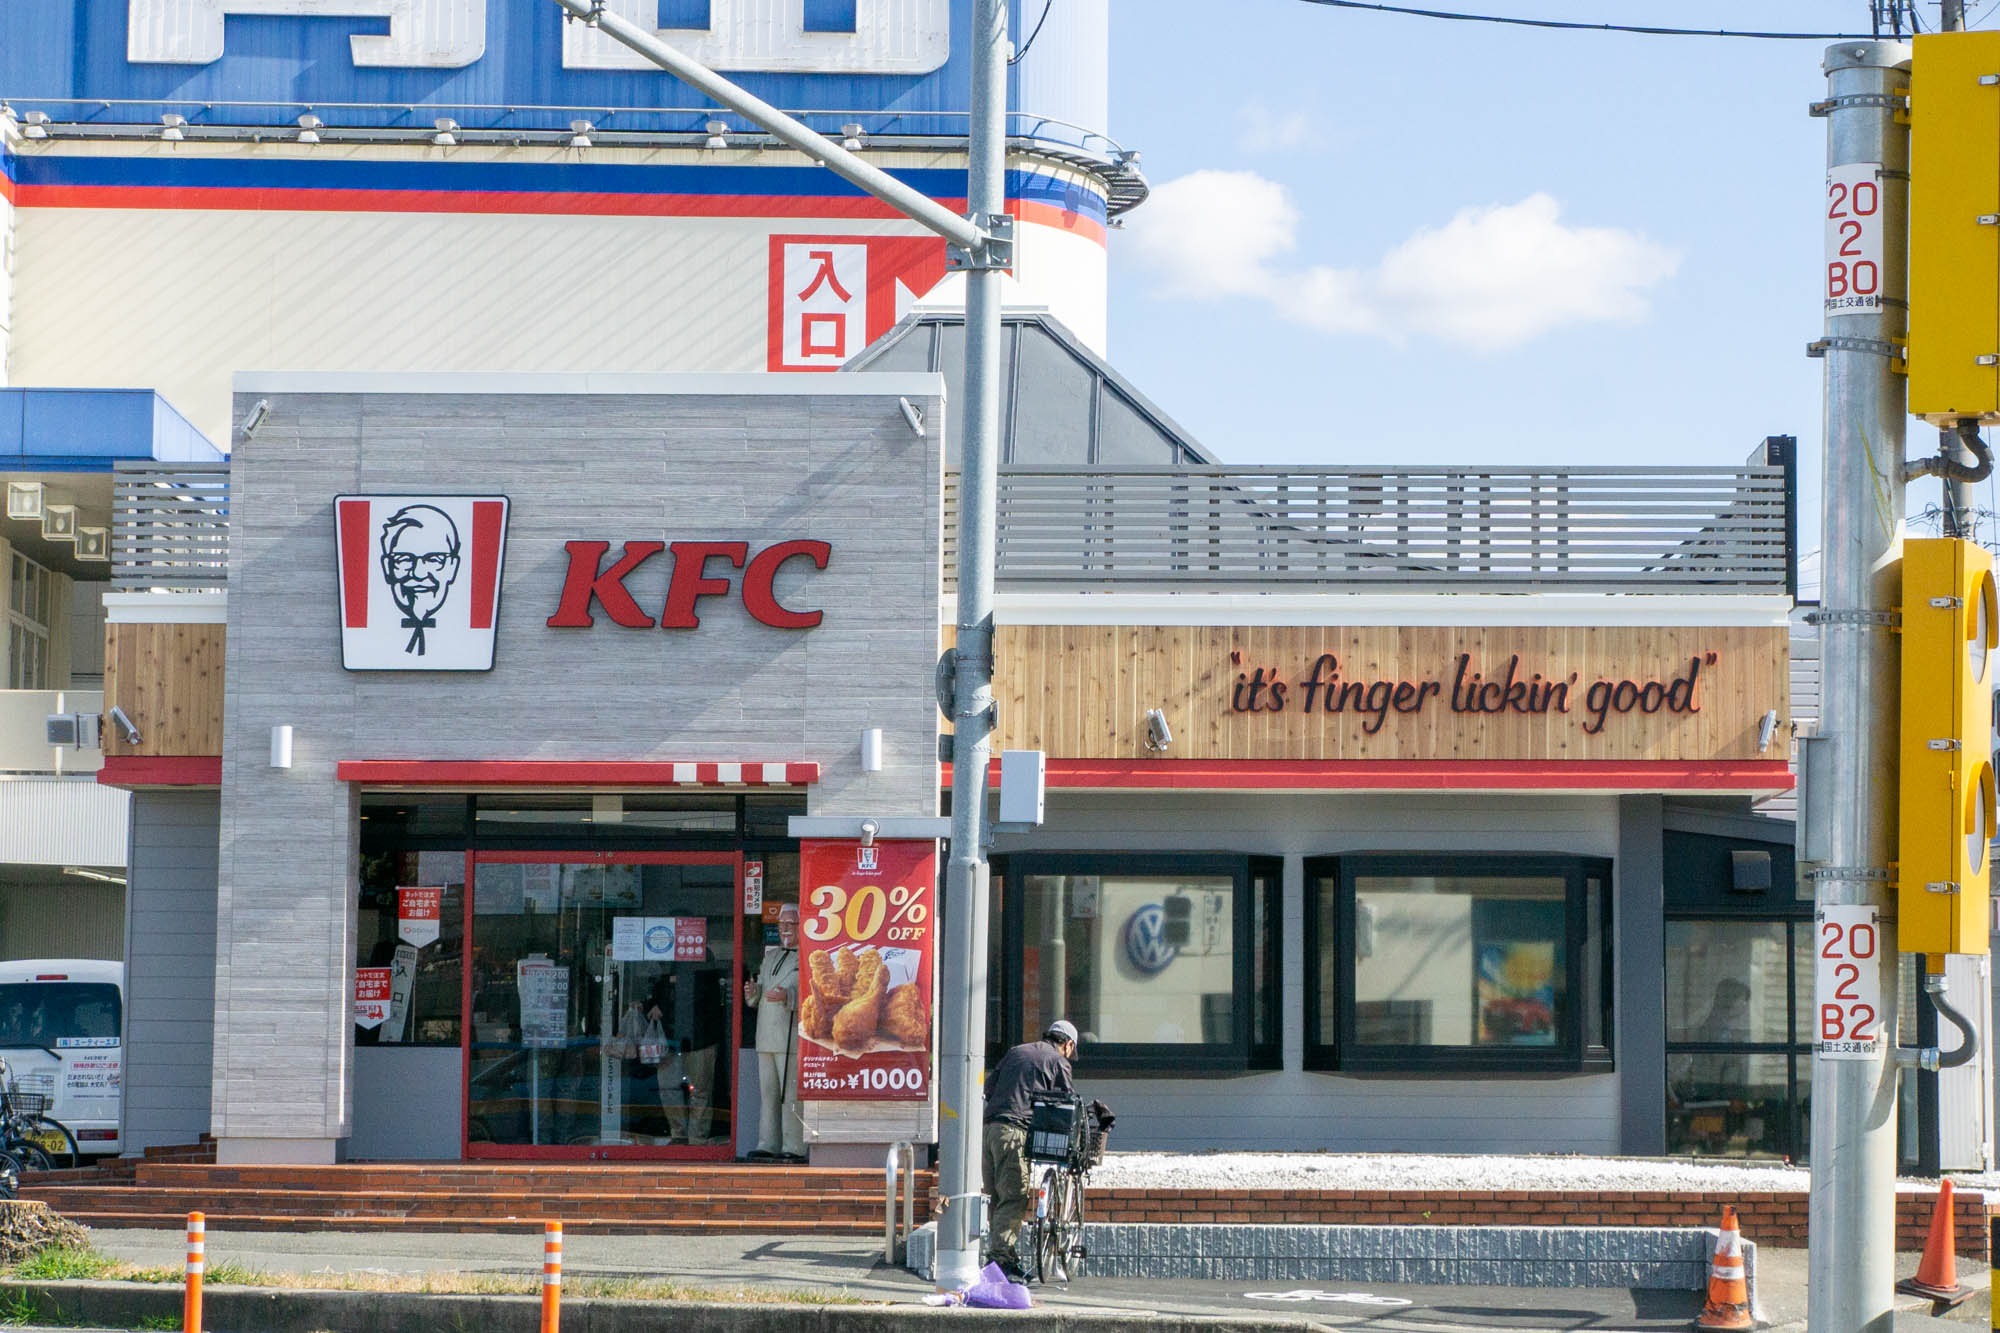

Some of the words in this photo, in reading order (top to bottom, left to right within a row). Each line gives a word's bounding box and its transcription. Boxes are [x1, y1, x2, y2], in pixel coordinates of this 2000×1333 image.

[1828, 182, 1878, 219] 20
[1839, 220, 1862, 256] 2
[797, 251, 852, 358] 入口
[1831, 296, 1874, 309] 国土交通省
[547, 539, 832, 628] KFC
[1300, 653, 1441, 735] finger
[402, 899, 437, 908] ご自宅まで
[753, 878, 761, 910] 防犯カメラ
[803, 885, 927, 941] 30%
[887, 927, 926, 940] OFF
[1822, 922, 1875, 959] 20
[1835, 963, 1860, 1000] 2
[1821, 1004, 1875, 1041] B2
[1824, 1041, 1872, 1054] 国土交通省
[803, 1079, 838, 1090] ¥1430
[847, 1068, 923, 1090] ¥1000
